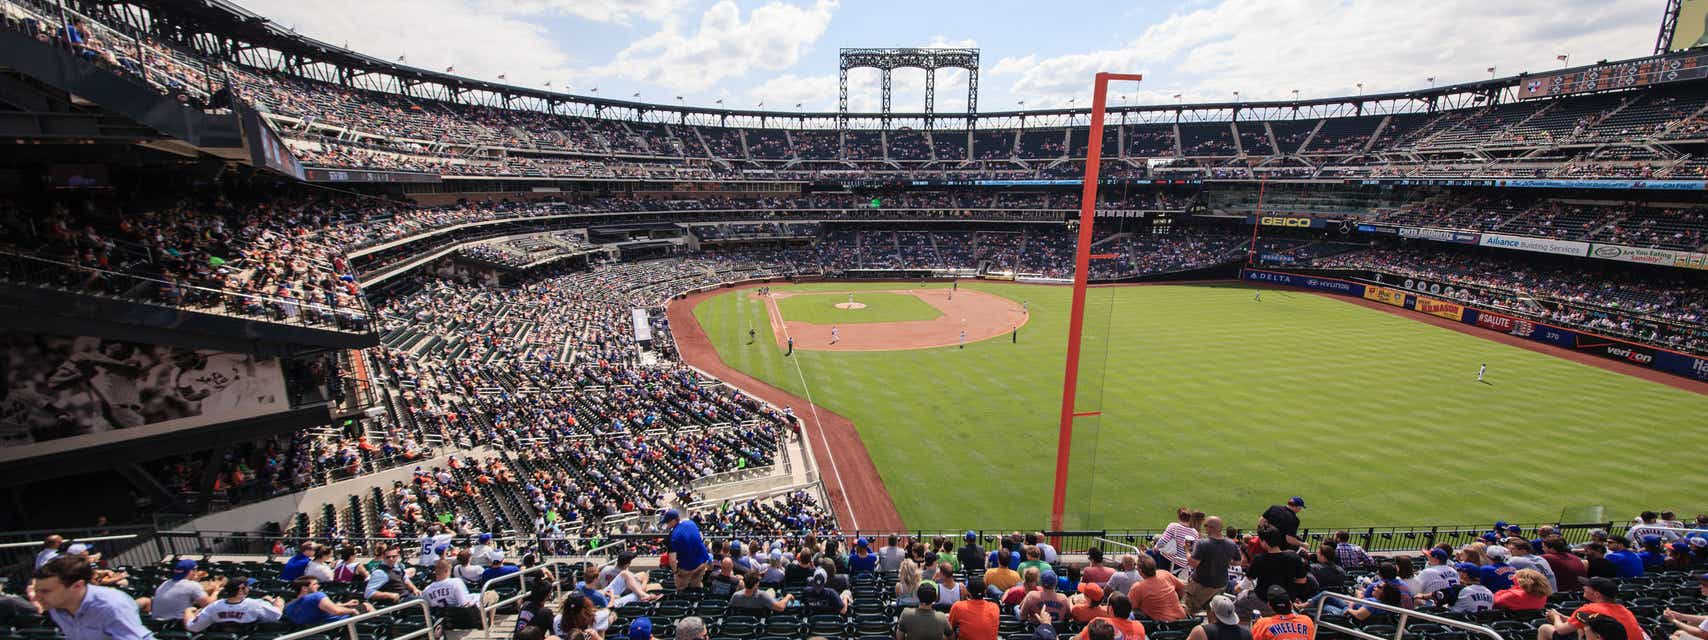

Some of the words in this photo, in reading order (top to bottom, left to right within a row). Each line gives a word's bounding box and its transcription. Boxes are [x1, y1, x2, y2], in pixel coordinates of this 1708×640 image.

[1261, 217, 1311, 227] GEICO
[1487, 236, 1520, 247] Alliance
[1520, 241, 1547, 251] Building
[1549, 244, 1579, 254] Services
[1649, 250, 1672, 259] Eating
[1260, 273, 1291, 282] DELTA
[1320, 281, 1350, 291] HYUNDAI
[1479, 313, 1511, 327] #SALUTE
[1546, 332, 1559, 340] 370
[1607, 346, 1652, 363] verizon
[428, 588, 450, 599] REYES
[1268, 622, 1308, 637] WHEELER
